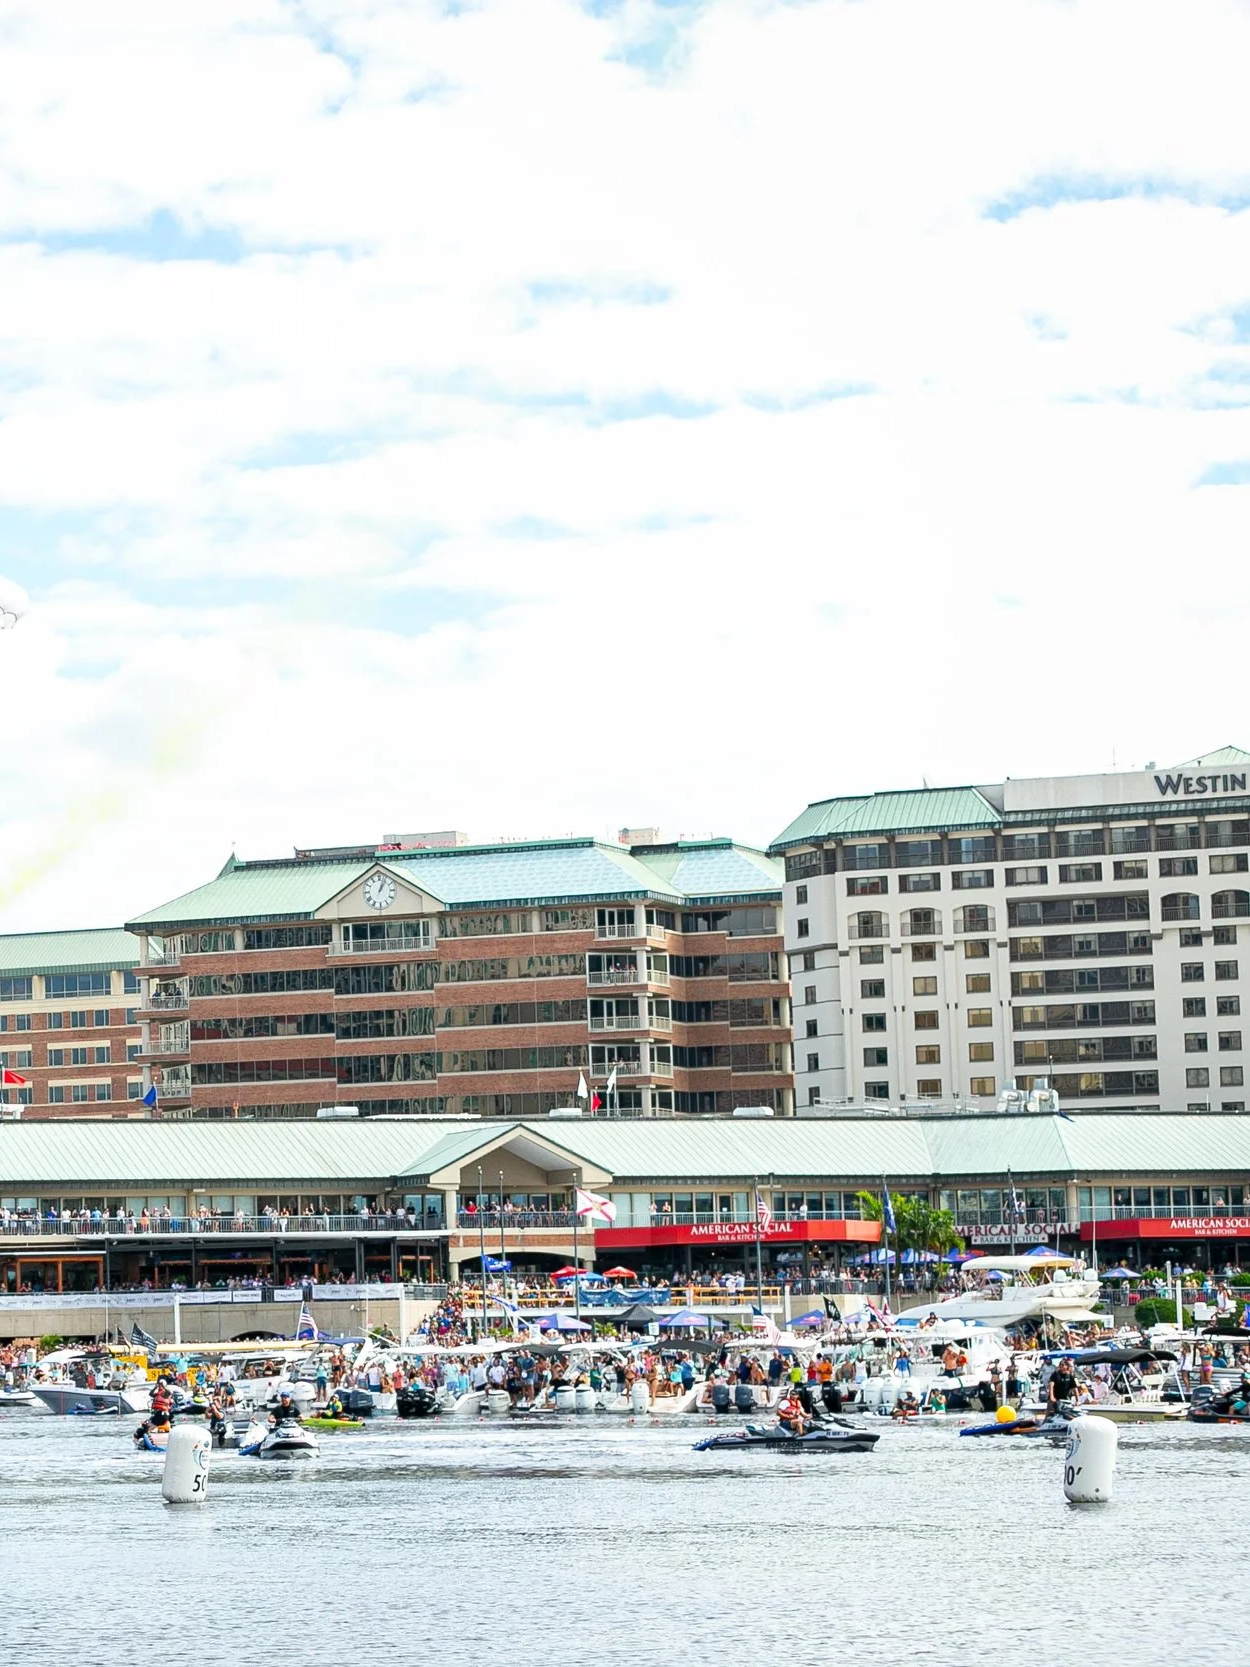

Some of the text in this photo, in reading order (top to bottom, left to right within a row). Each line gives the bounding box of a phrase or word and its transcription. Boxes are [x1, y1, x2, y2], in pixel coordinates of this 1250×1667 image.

[1153, 773, 1246, 796] WESTIN
[690, 1223, 749, 1235] AMERICAN
[955, 1223, 1073, 1237] MERICAN SOCIAL
[1170, 1218, 1250, 1229] AMERICAN SOCI
